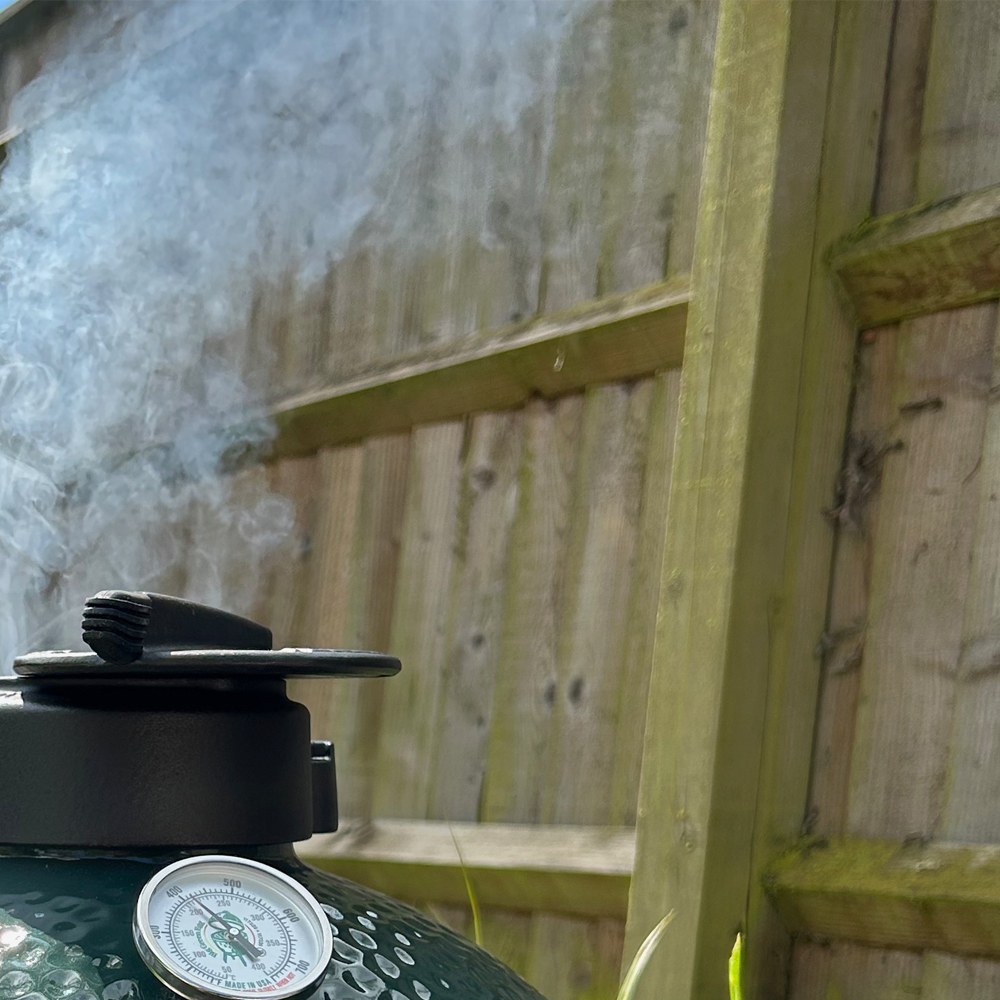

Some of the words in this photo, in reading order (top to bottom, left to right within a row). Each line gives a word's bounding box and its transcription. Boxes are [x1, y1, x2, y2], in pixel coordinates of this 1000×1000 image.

[223, 878, 242, 889] 500
[166, 885, 183, 898] 400
[189, 908, 204, 916] 200
[282, 908, 300, 923] 600
[265, 939, 280, 947] 350
[295, 959, 310, 975] 700
[224, 980, 246, 989] MADE
[248, 981, 257, 989] IN
[256, 978, 272, 989] USA
